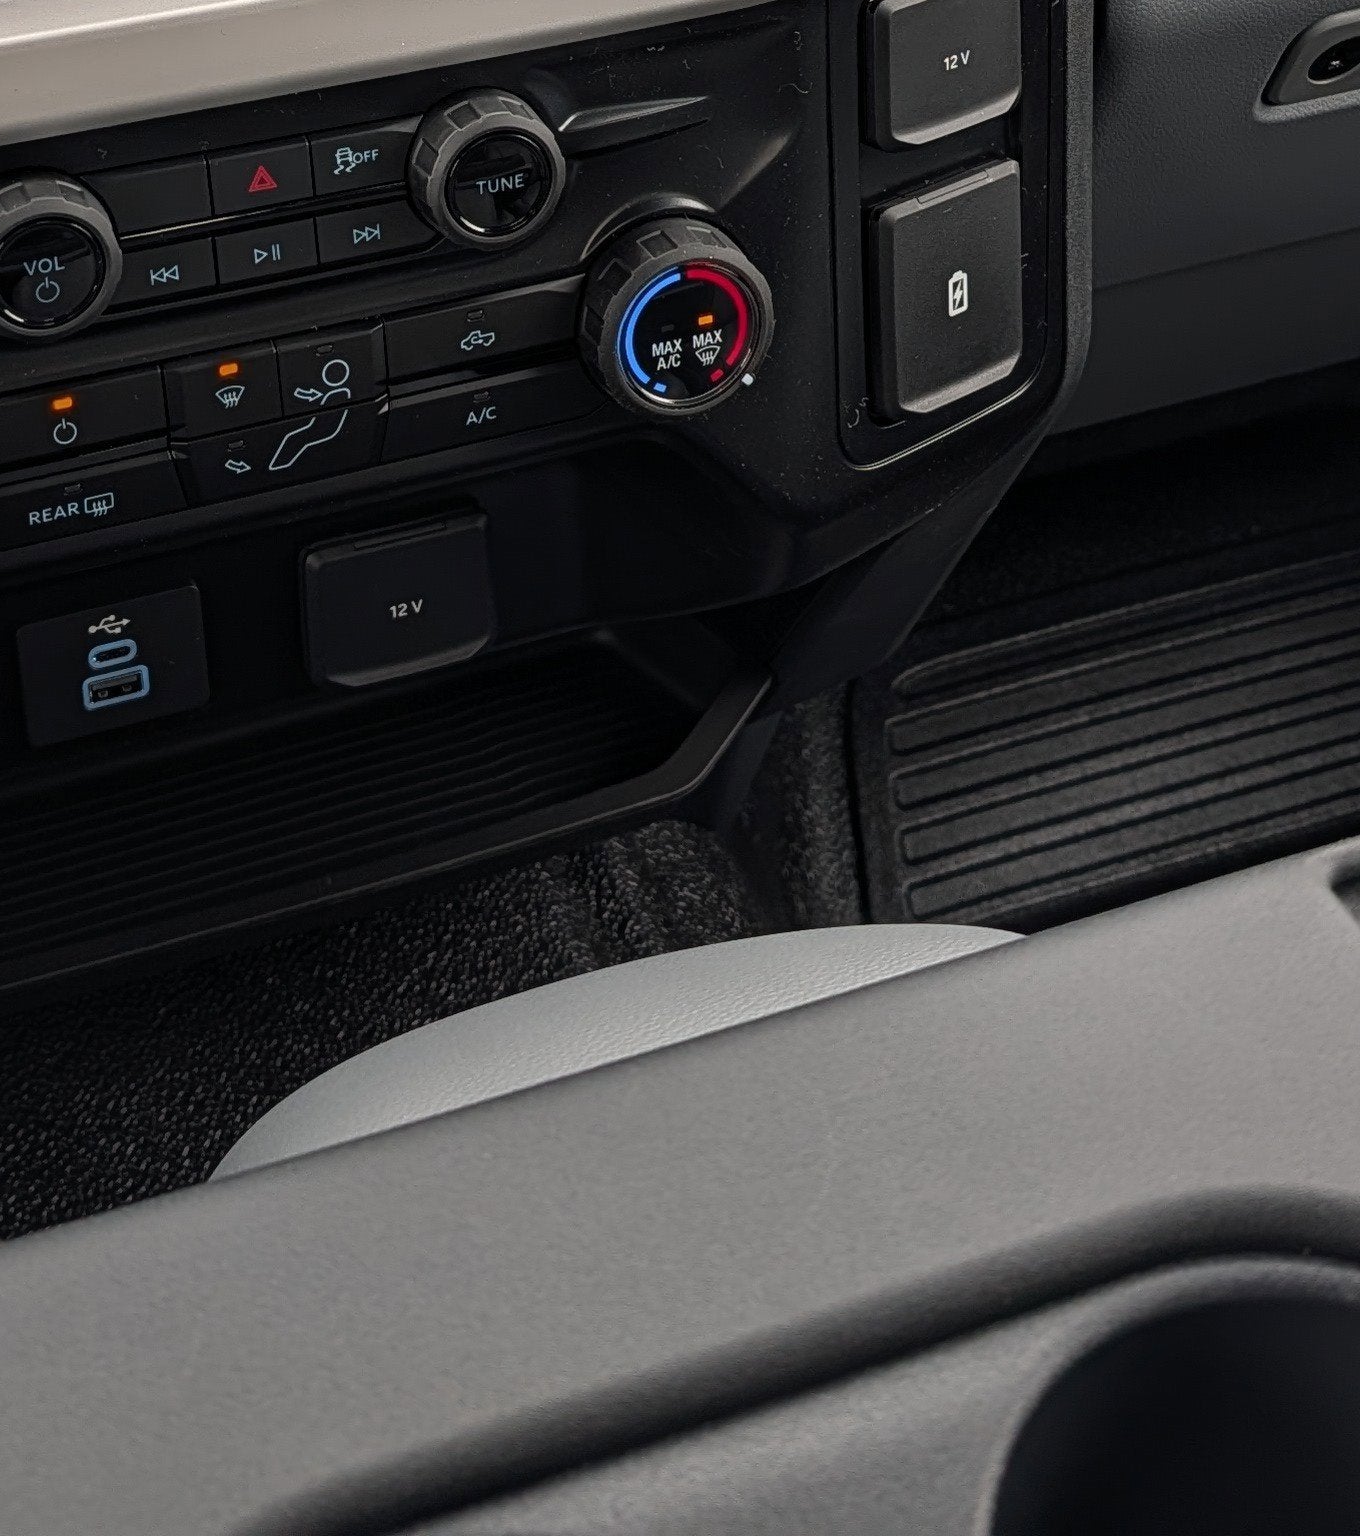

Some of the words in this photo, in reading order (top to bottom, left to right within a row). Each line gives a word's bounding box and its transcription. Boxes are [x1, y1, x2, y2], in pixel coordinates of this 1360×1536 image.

[352, 149, 379, 164] OFF
[476, 173, 525, 196] TUNE
[23, 256, 66, 277] VOL
[651, 338, 683, 358] MAX
[692, 329, 723, 349] MAX
[657, 354, 681, 371] A/C
[465, 406, 497, 427] A/C
[29, 501, 81, 527] REAR
